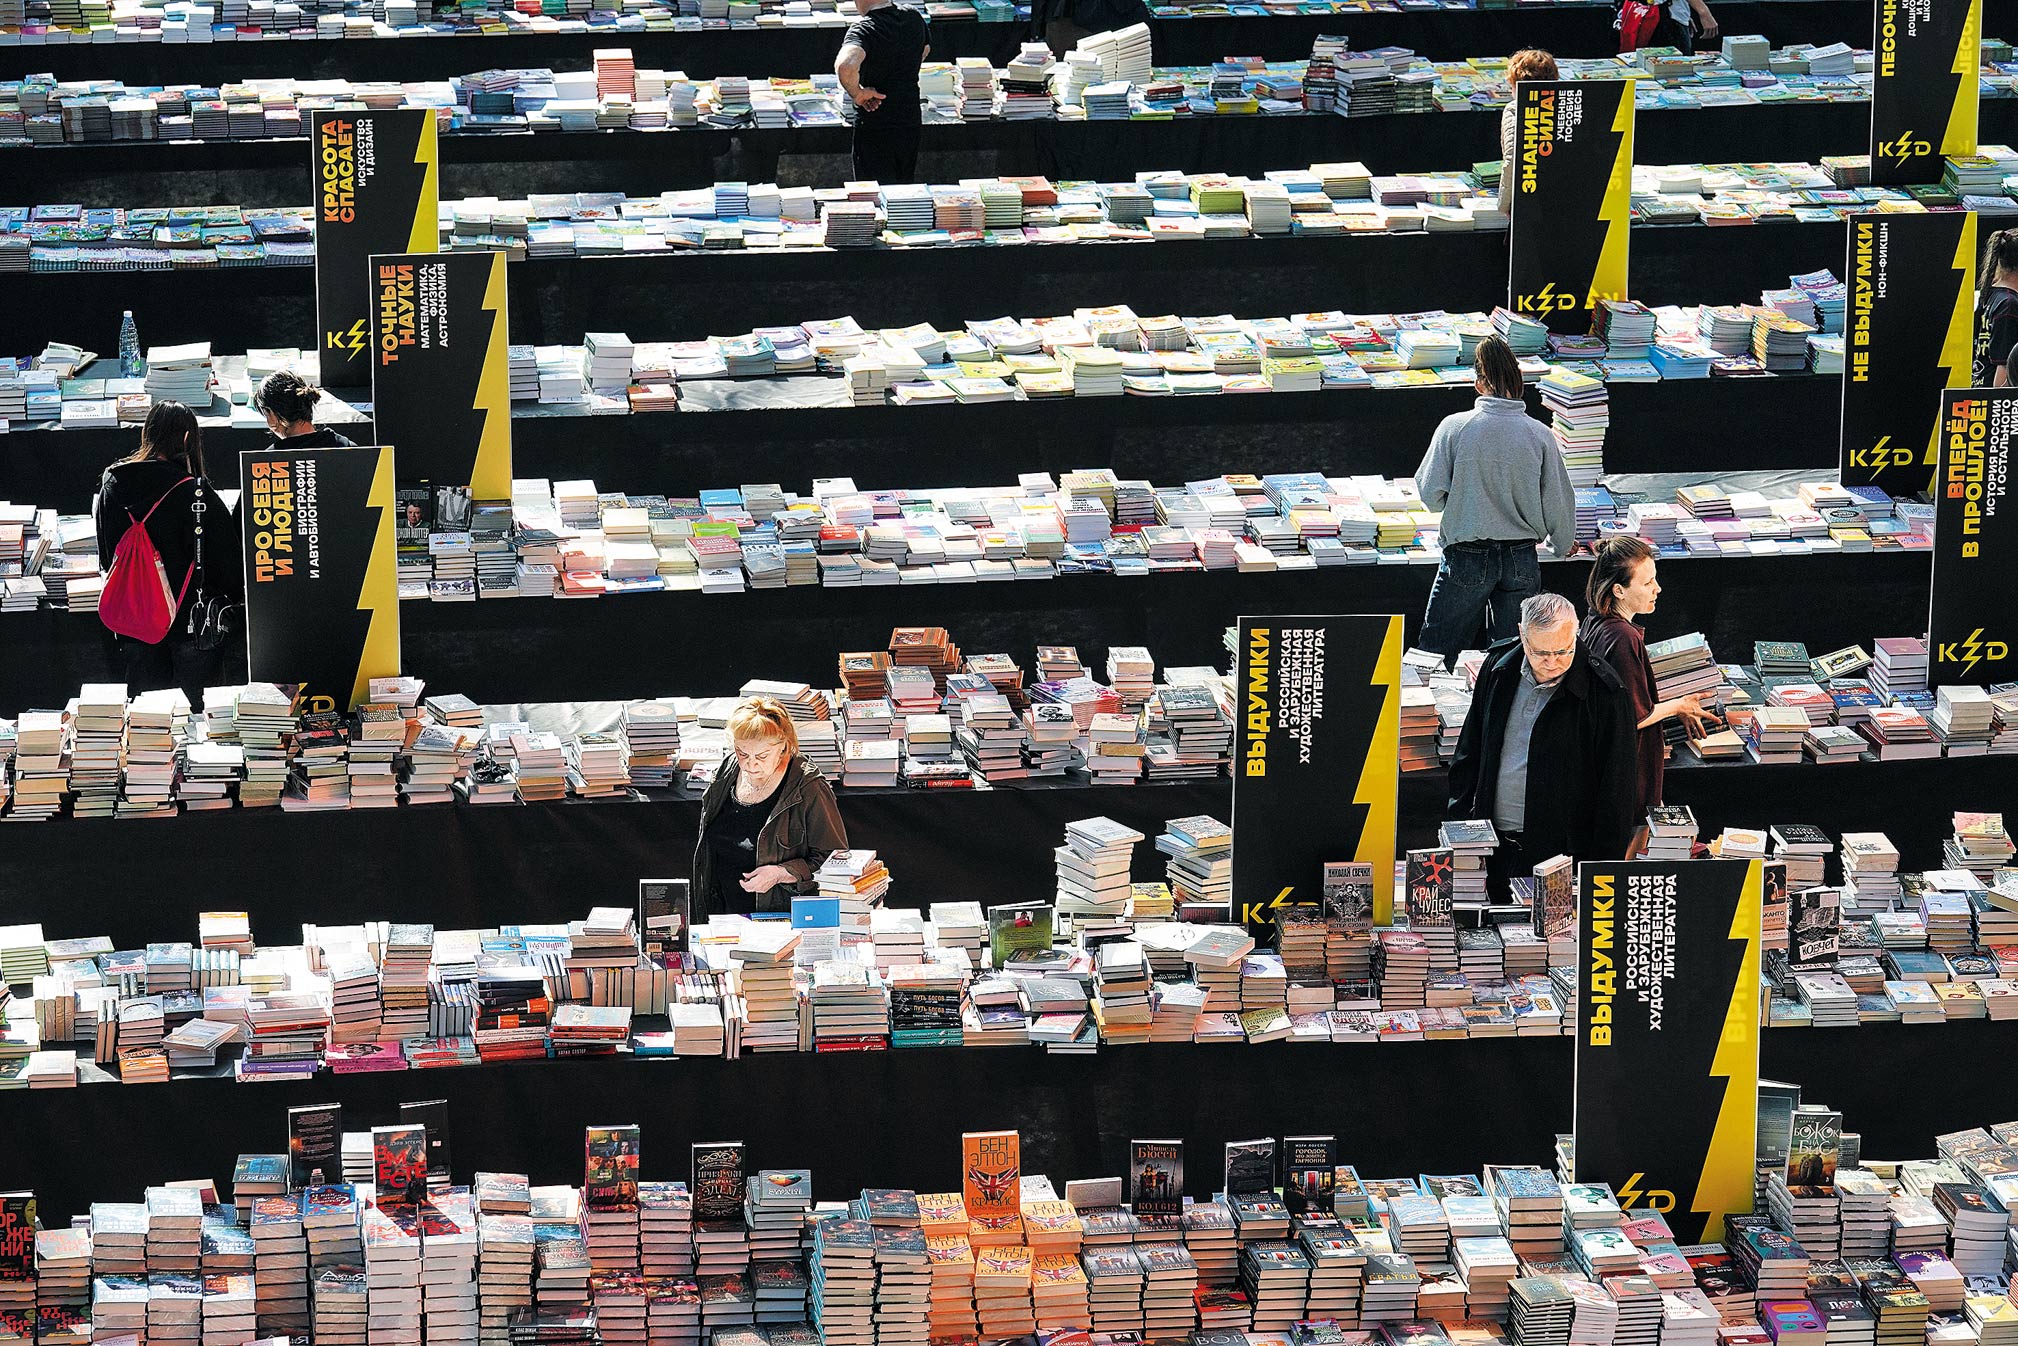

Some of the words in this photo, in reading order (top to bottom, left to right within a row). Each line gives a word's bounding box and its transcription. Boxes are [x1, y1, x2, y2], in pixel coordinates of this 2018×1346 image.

[1539, 90, 1555, 156] СИЛА!
[1557, 90, 1567, 141] УЧЕБНЫЕ
[1565, 90, 1574, 142] ПОСОБИЯ
[1574, 89, 1583, 125] ЗДЕСЬ
[323, 120, 339, 222] КРАСОТА
[337, 120, 355, 223] СПАСАЕТ
[358, 119, 367, 186] ИСКУССТВО
[367, 167, 375, 176] И
[1522, 107, 1539, 193] ЗНАНИЕ
[429, 264, 437, 316] ФИЗИКА,
[1855, 223, 1873, 346] ВЫДУМКИ
[1878, 223, 1888, 298] НОН-ФИКШН
[380, 265, 398, 365] ТОЧНЫЕ
[397, 265, 416, 345] НАУКИ
[419, 264, 429, 349] МАТЕМАТИКА,
[437, 264, 448, 347] АСТРОНОМИЯ
[1853, 352, 1869, 382] НЕ
[1946, 400, 1972, 498] ВПЕРЁД
[1990, 400, 2001, 453] РОССИИ
[1998, 400, 2011, 484] ОСТАЛЬНОГО
[2010, 400, 2018, 435] МИРА
[252, 462, 272, 526] СЕБЯ
[296, 460, 307, 535] БИОГРАФИИ
[1963, 400, 1987, 535] ПРОШЛОЕ!
[1986, 457, 1999, 516] ИСТОРИЯ
[1997, 488, 2006, 496] И
[306, 459, 319, 566] АВТОБИОГРАФИИ
[1962, 542, 1979, 558] В
[255, 531, 274, 582] ПРО
[275, 559, 293, 576] И
[310, 569, 320, 578] И
[1246, 628, 1270, 777] ВЫДУМКИ
[1276, 629, 1292, 728] РОССИЙСКАЯ
[1290, 629, 1303, 726] ЗАРУБЕЖНАЯ
[1300, 629, 1314, 764] ХУДОЖЕСТВЕННАЯ
[1312, 628, 1326, 719] ЛИТЕРАТУРА
[1289, 729, 1299, 739] И
[1412, 885, 1439, 901] КРАЙ
[1419, 898, 1451, 915] ЧУДЕС
[1663, 874, 1677, 979] ЛИТЕРАТУРА
[1590, 875, 1615, 1046] ВЫДУМКИ
[1624, 876, 1640, 989] РОССИЙСКАЯ
[1638, 876, 1652, 986] ЗАРУБЕЖНАЯ
[1649, 875, 1664, 1031] ХУДОЖЕСТВЕННАЯ
[1638, 991, 1650, 1002] И
[970, 1152, 1015, 1167] ЭЛТОН
[980, 1138, 1008, 1152] БЕН
